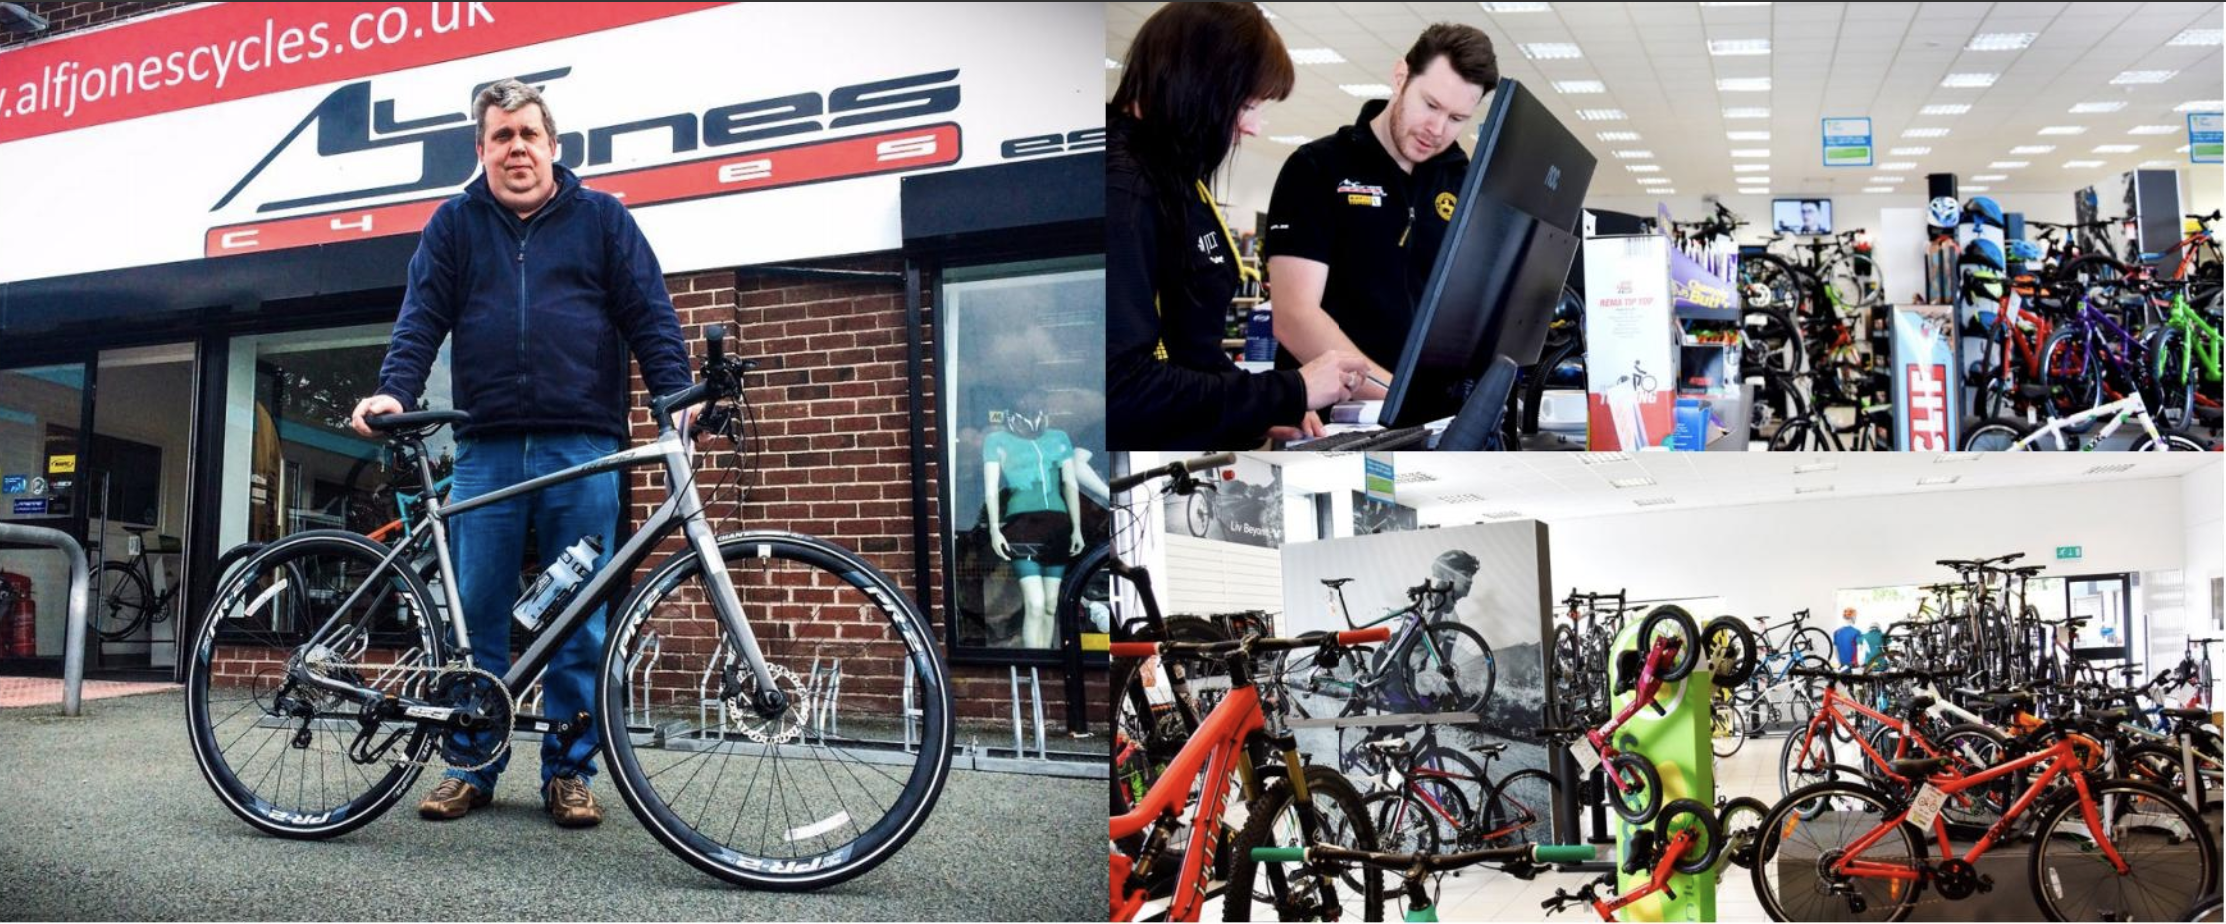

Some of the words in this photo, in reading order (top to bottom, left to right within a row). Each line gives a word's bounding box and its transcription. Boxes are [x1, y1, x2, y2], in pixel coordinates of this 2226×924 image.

[0, 3, 495, 118] .alfjonescycles.co.uk
[1600, 297, 1623, 307] REMA
[1625, 297, 1637, 307] TIP
[1639, 297, 1655, 306] TOP
[267, 808, 333, 826] PR-2
